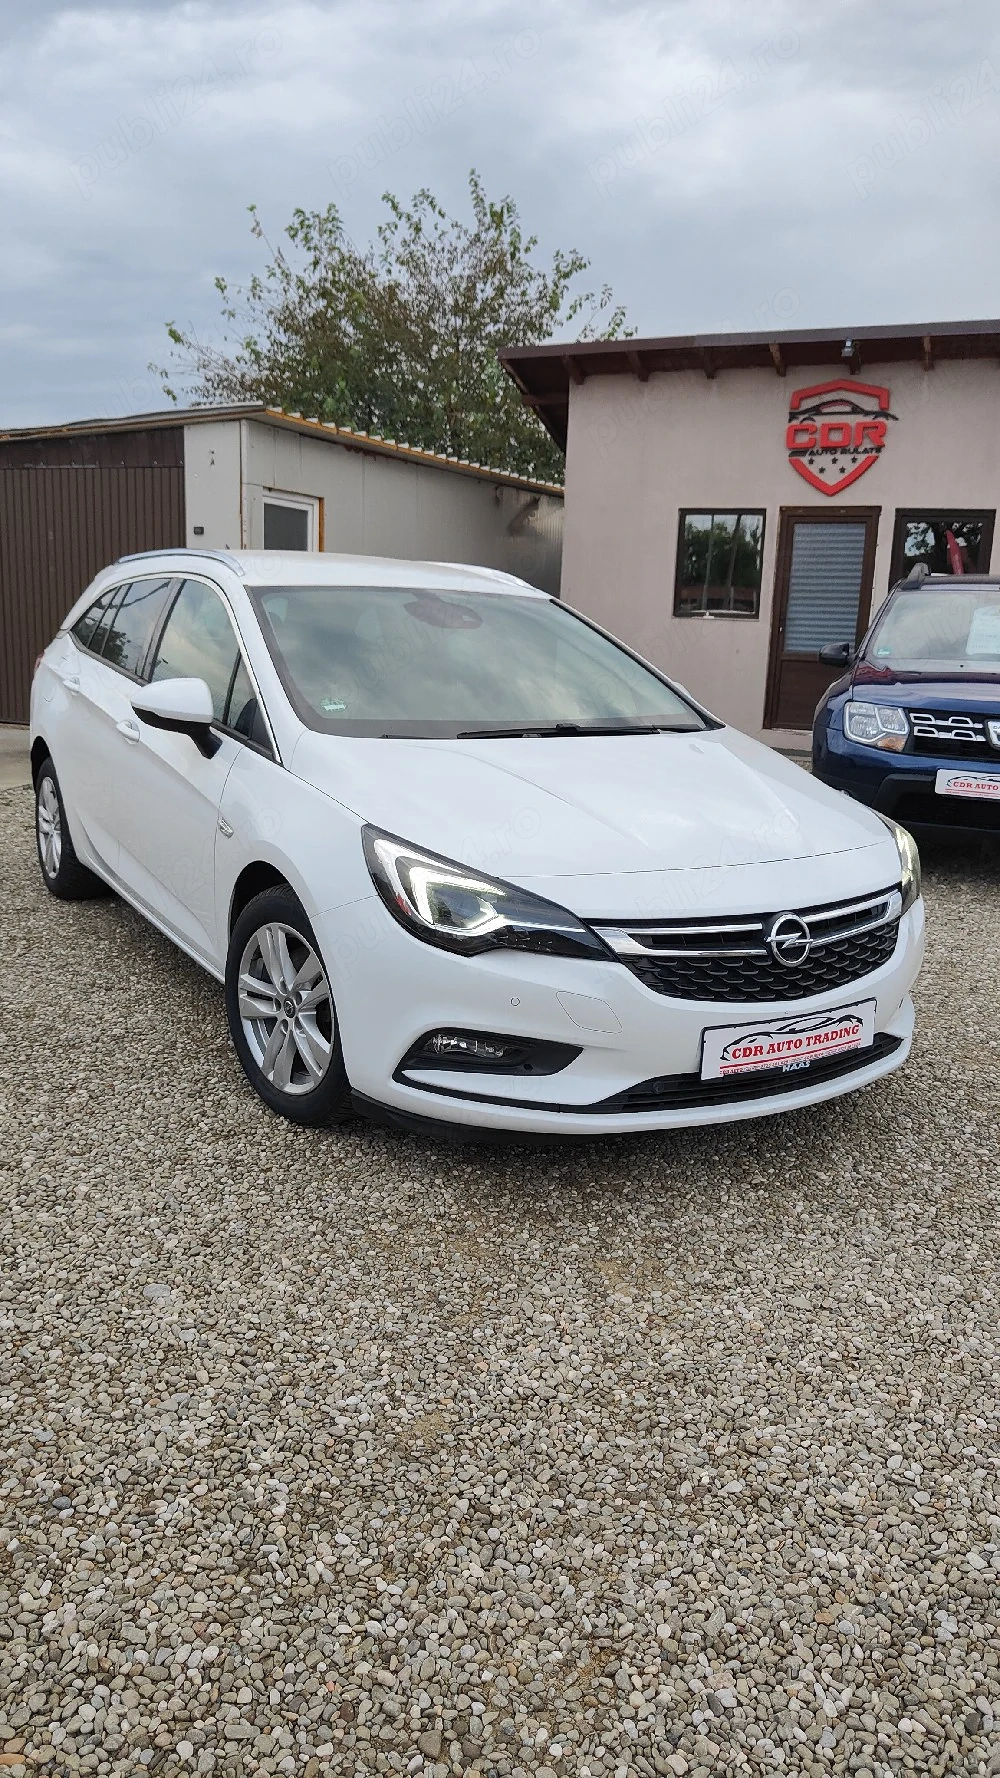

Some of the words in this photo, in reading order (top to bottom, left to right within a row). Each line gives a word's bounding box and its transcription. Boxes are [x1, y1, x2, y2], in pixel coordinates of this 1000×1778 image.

[786, 420, 887, 449] CDR
[808, 448, 837, 456] AUTO
[731, 1045, 764, 1060] CDR
[766, 1038, 803, 1055] AUTO
[805, 1024, 861, 1048] TRADING
